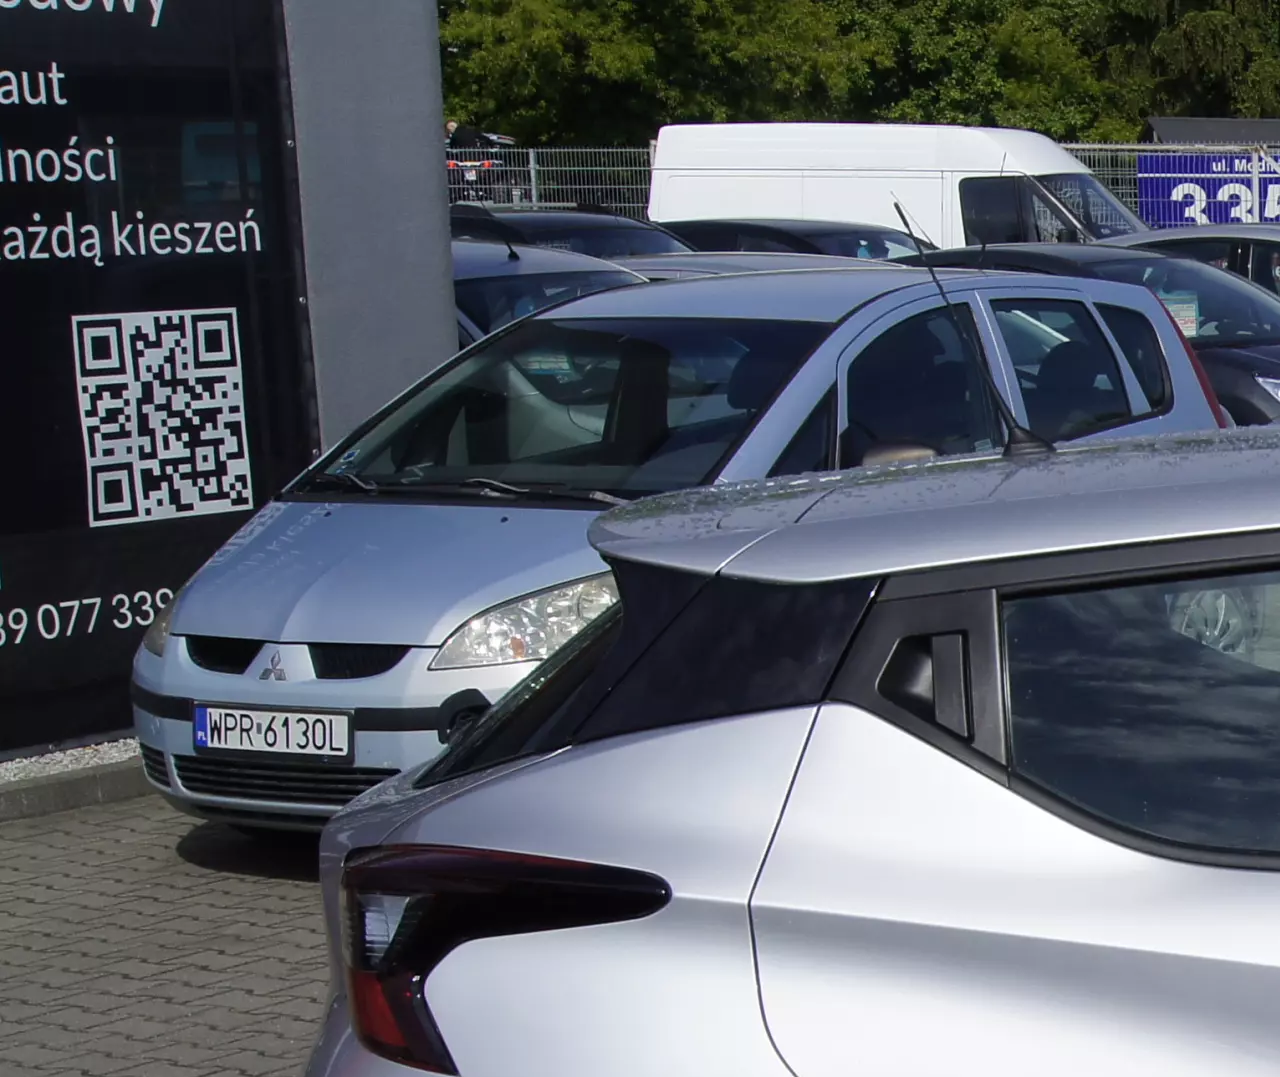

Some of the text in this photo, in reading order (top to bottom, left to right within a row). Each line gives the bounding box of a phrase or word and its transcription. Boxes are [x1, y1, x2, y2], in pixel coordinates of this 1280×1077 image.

[0, 62, 67, 105] aut
[0, 136, 117, 182] ności
[1212, 159, 1230, 172] ul.
[0, 208, 262, 266] ażdą kieszeń
[37, 598, 102, 640] 077
[209, 711, 344, 752] WPR 6130L
